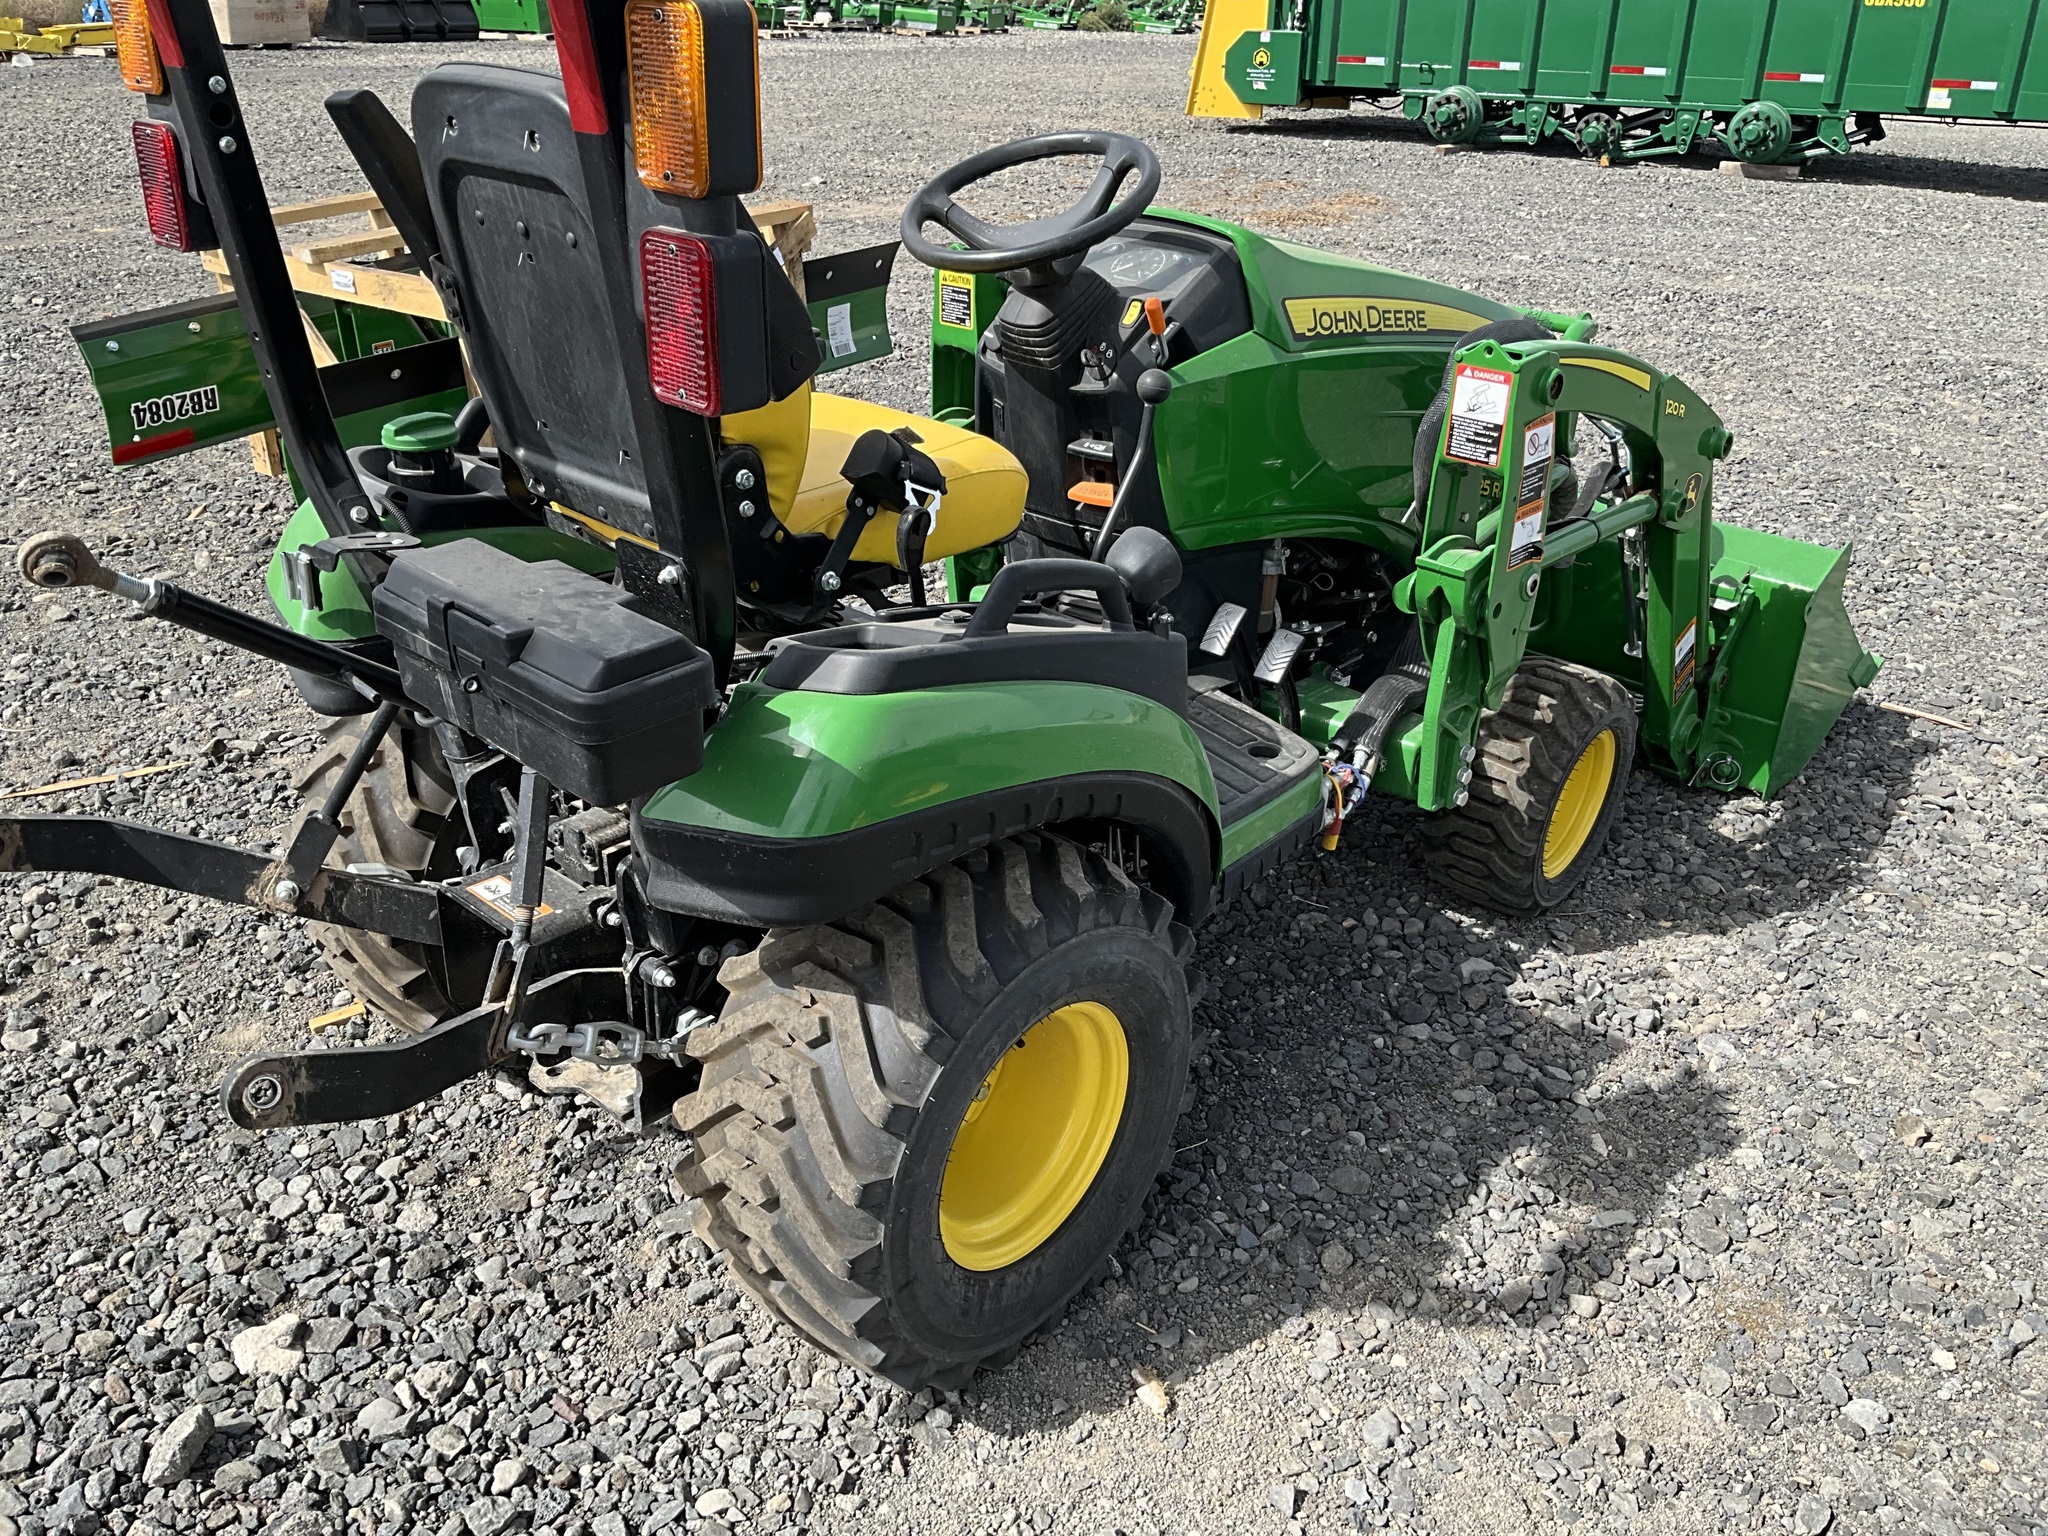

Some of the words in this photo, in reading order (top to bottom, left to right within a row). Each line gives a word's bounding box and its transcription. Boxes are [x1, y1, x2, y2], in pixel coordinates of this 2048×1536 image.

[948, 274, 971, 286] CAUTION
[1306, 308, 1363, 334] JOHN
[1366, 305, 1428, 332] DEERE
[1473, 370, 1505, 383] DANGER
[130, 384, 220, 430] RB2084
[1531, 413, 1554, 428] WARNING
[1521, 502, 1543, 518] WARNING
